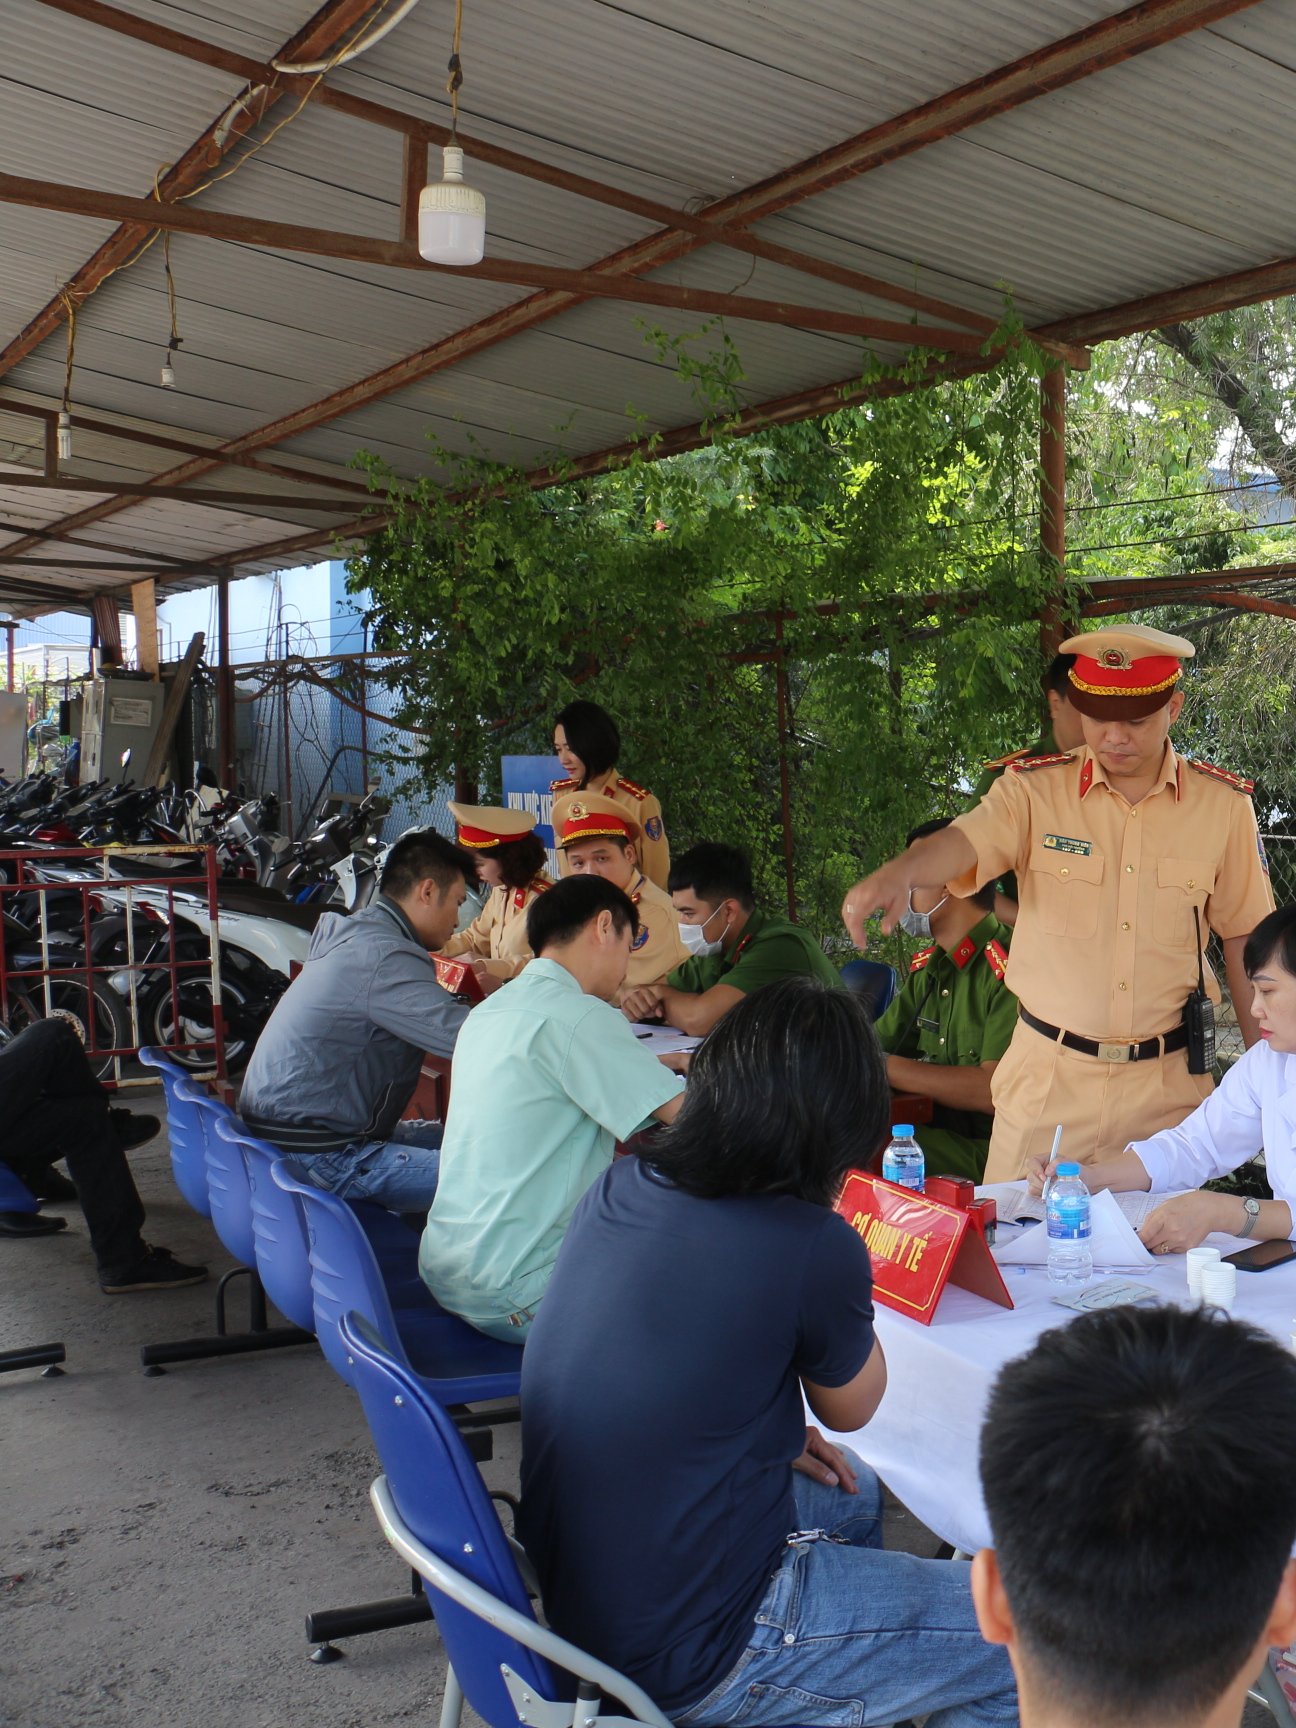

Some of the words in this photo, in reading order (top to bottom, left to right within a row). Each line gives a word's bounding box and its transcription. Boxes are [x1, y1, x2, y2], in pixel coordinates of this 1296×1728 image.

[864, 1219, 901, 1260] QUAN
[895, 1232, 912, 1264] Y
[904, 1231, 933, 1273] TẾ
